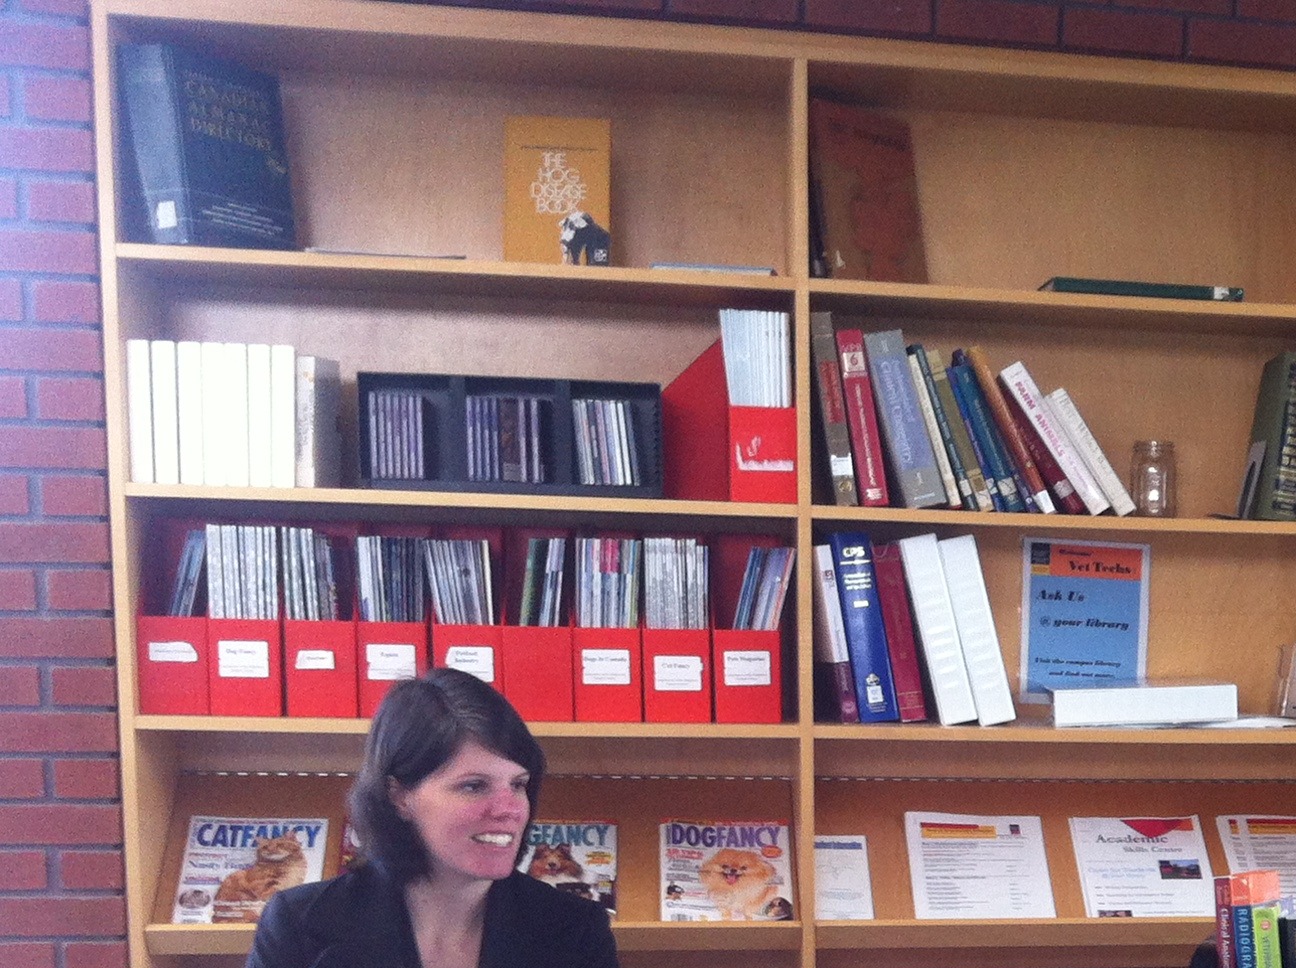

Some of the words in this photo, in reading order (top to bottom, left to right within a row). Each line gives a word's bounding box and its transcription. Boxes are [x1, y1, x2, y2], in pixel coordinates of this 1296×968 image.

[1036, 589, 1063, 601] Ask
[1053, 618, 1083, 628] your
[1086, 618, 1129, 631] library
[672, 823, 780, 848] DOGFANCY
[1096, 834, 1169, 844] Academic
